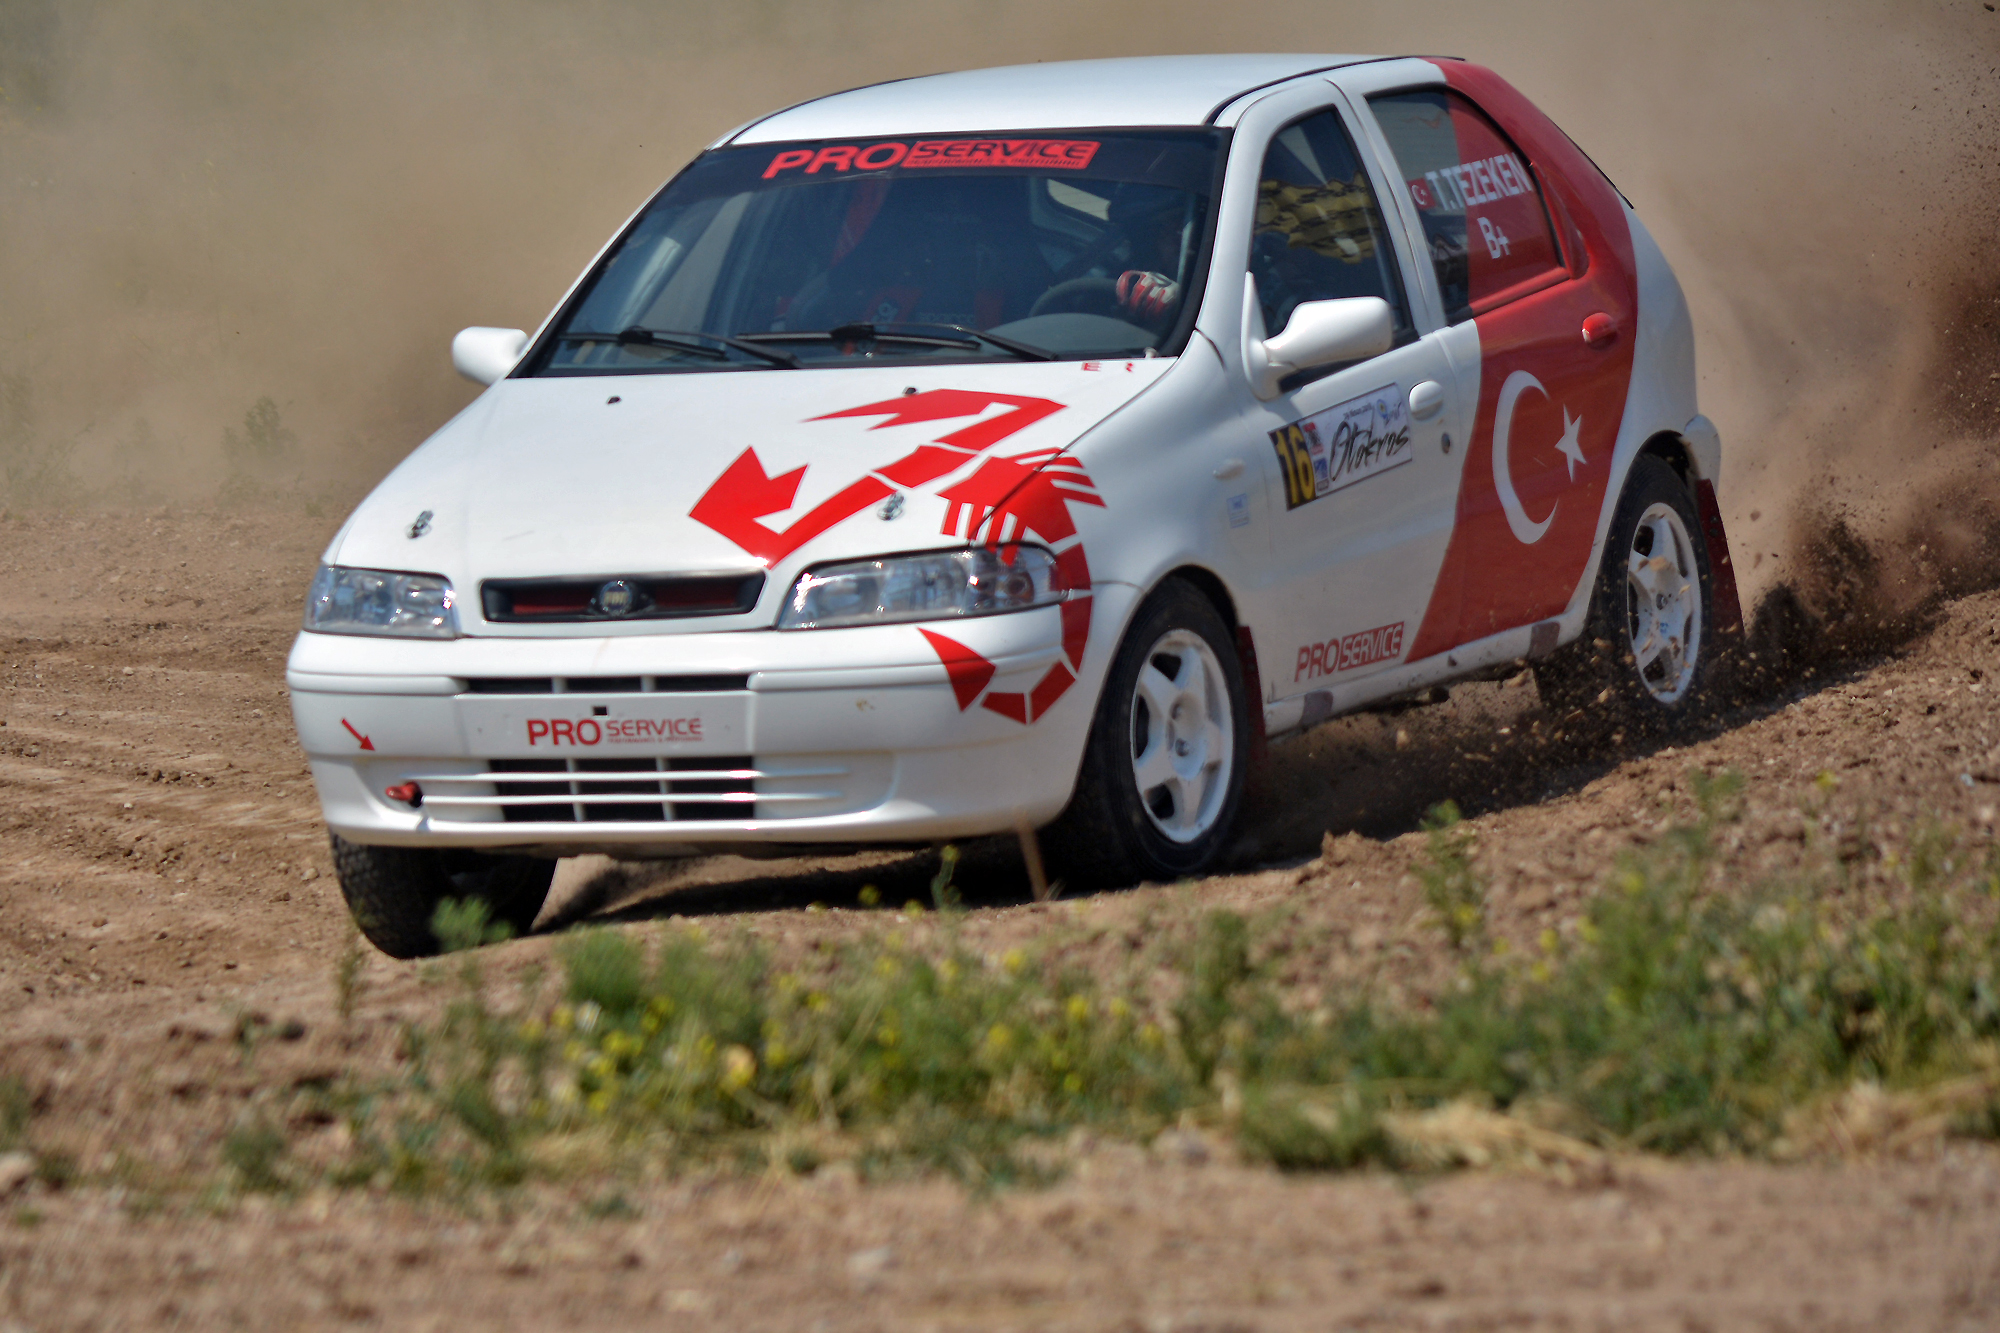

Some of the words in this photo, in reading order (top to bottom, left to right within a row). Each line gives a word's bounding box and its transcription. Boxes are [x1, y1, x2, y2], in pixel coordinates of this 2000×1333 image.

[912, 141, 1093, 159] SERVICE
[1425, 152, 1532, 211] T.TEZEKEN
[1477, 216, 1510, 259] B+
[1275, 425, 1315, 504] 16
[1340, 624, 1402, 669] SERVICE
[526, 719, 601, 746] PRO
[606, 718, 702, 737] SERVICE
